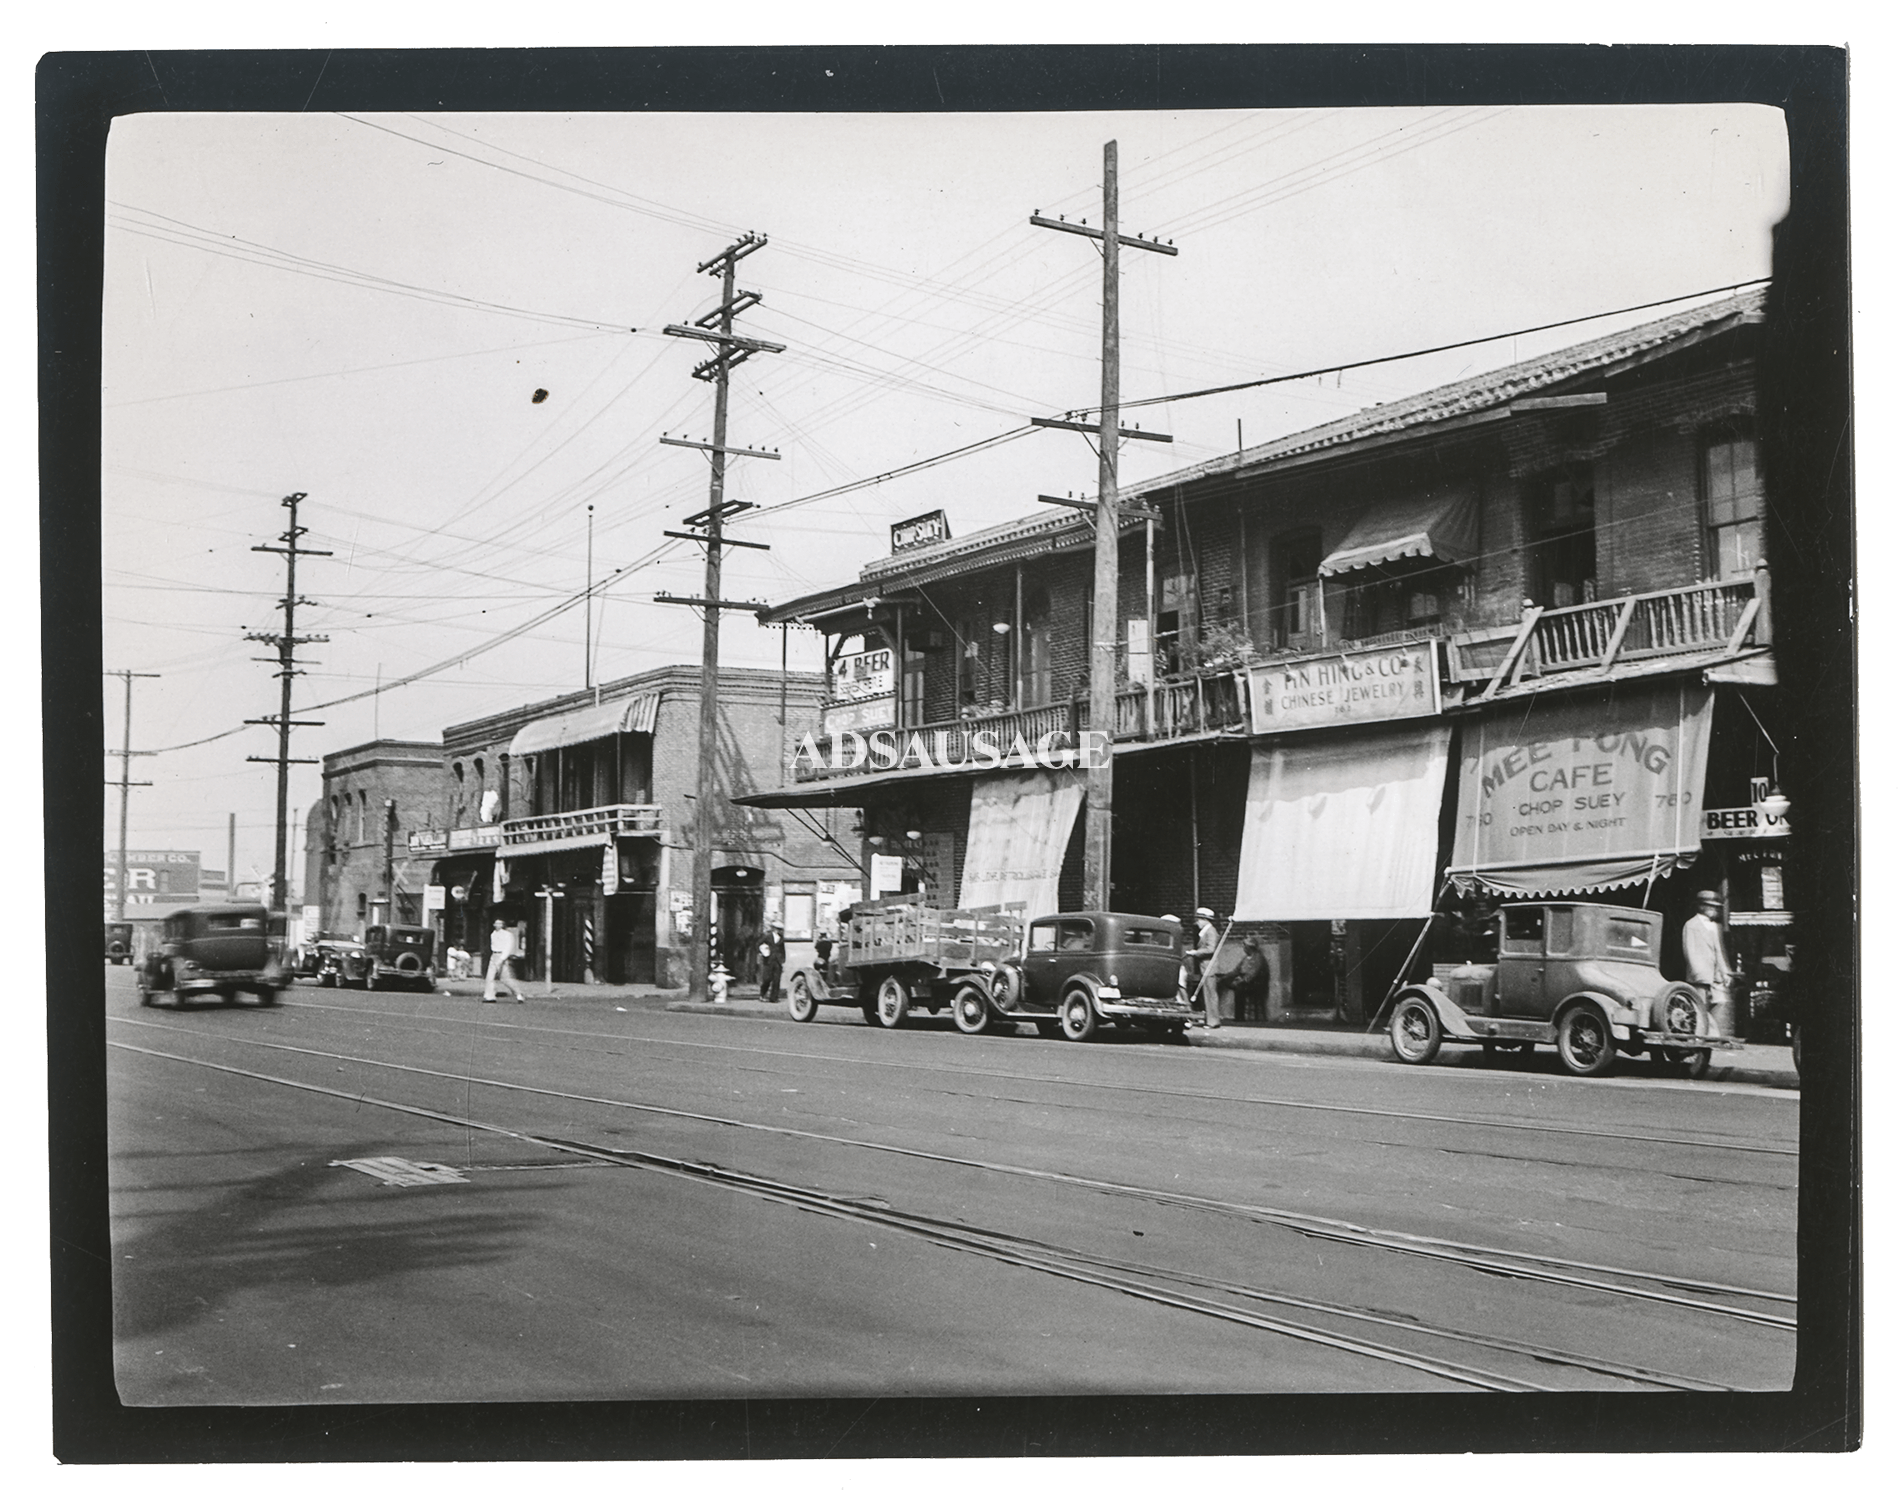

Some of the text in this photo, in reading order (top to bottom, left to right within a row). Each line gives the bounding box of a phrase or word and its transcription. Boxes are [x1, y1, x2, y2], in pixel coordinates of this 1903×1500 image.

[854, 651, 890, 672] BEER
[1281, 681, 1405, 710] CHINESE JEWELRY
[1481, 739, 1552, 798] MEE
[1529, 763, 1613, 793] CAFE
[1518, 791, 1626, 816] CHOP SUEY
[1509, 824, 1543, 837] OPEN
[1548, 823, 1569, 833] DAY
[1586, 817, 1627, 830] NIGHT
[1707, 810, 1758, 829] BEER
